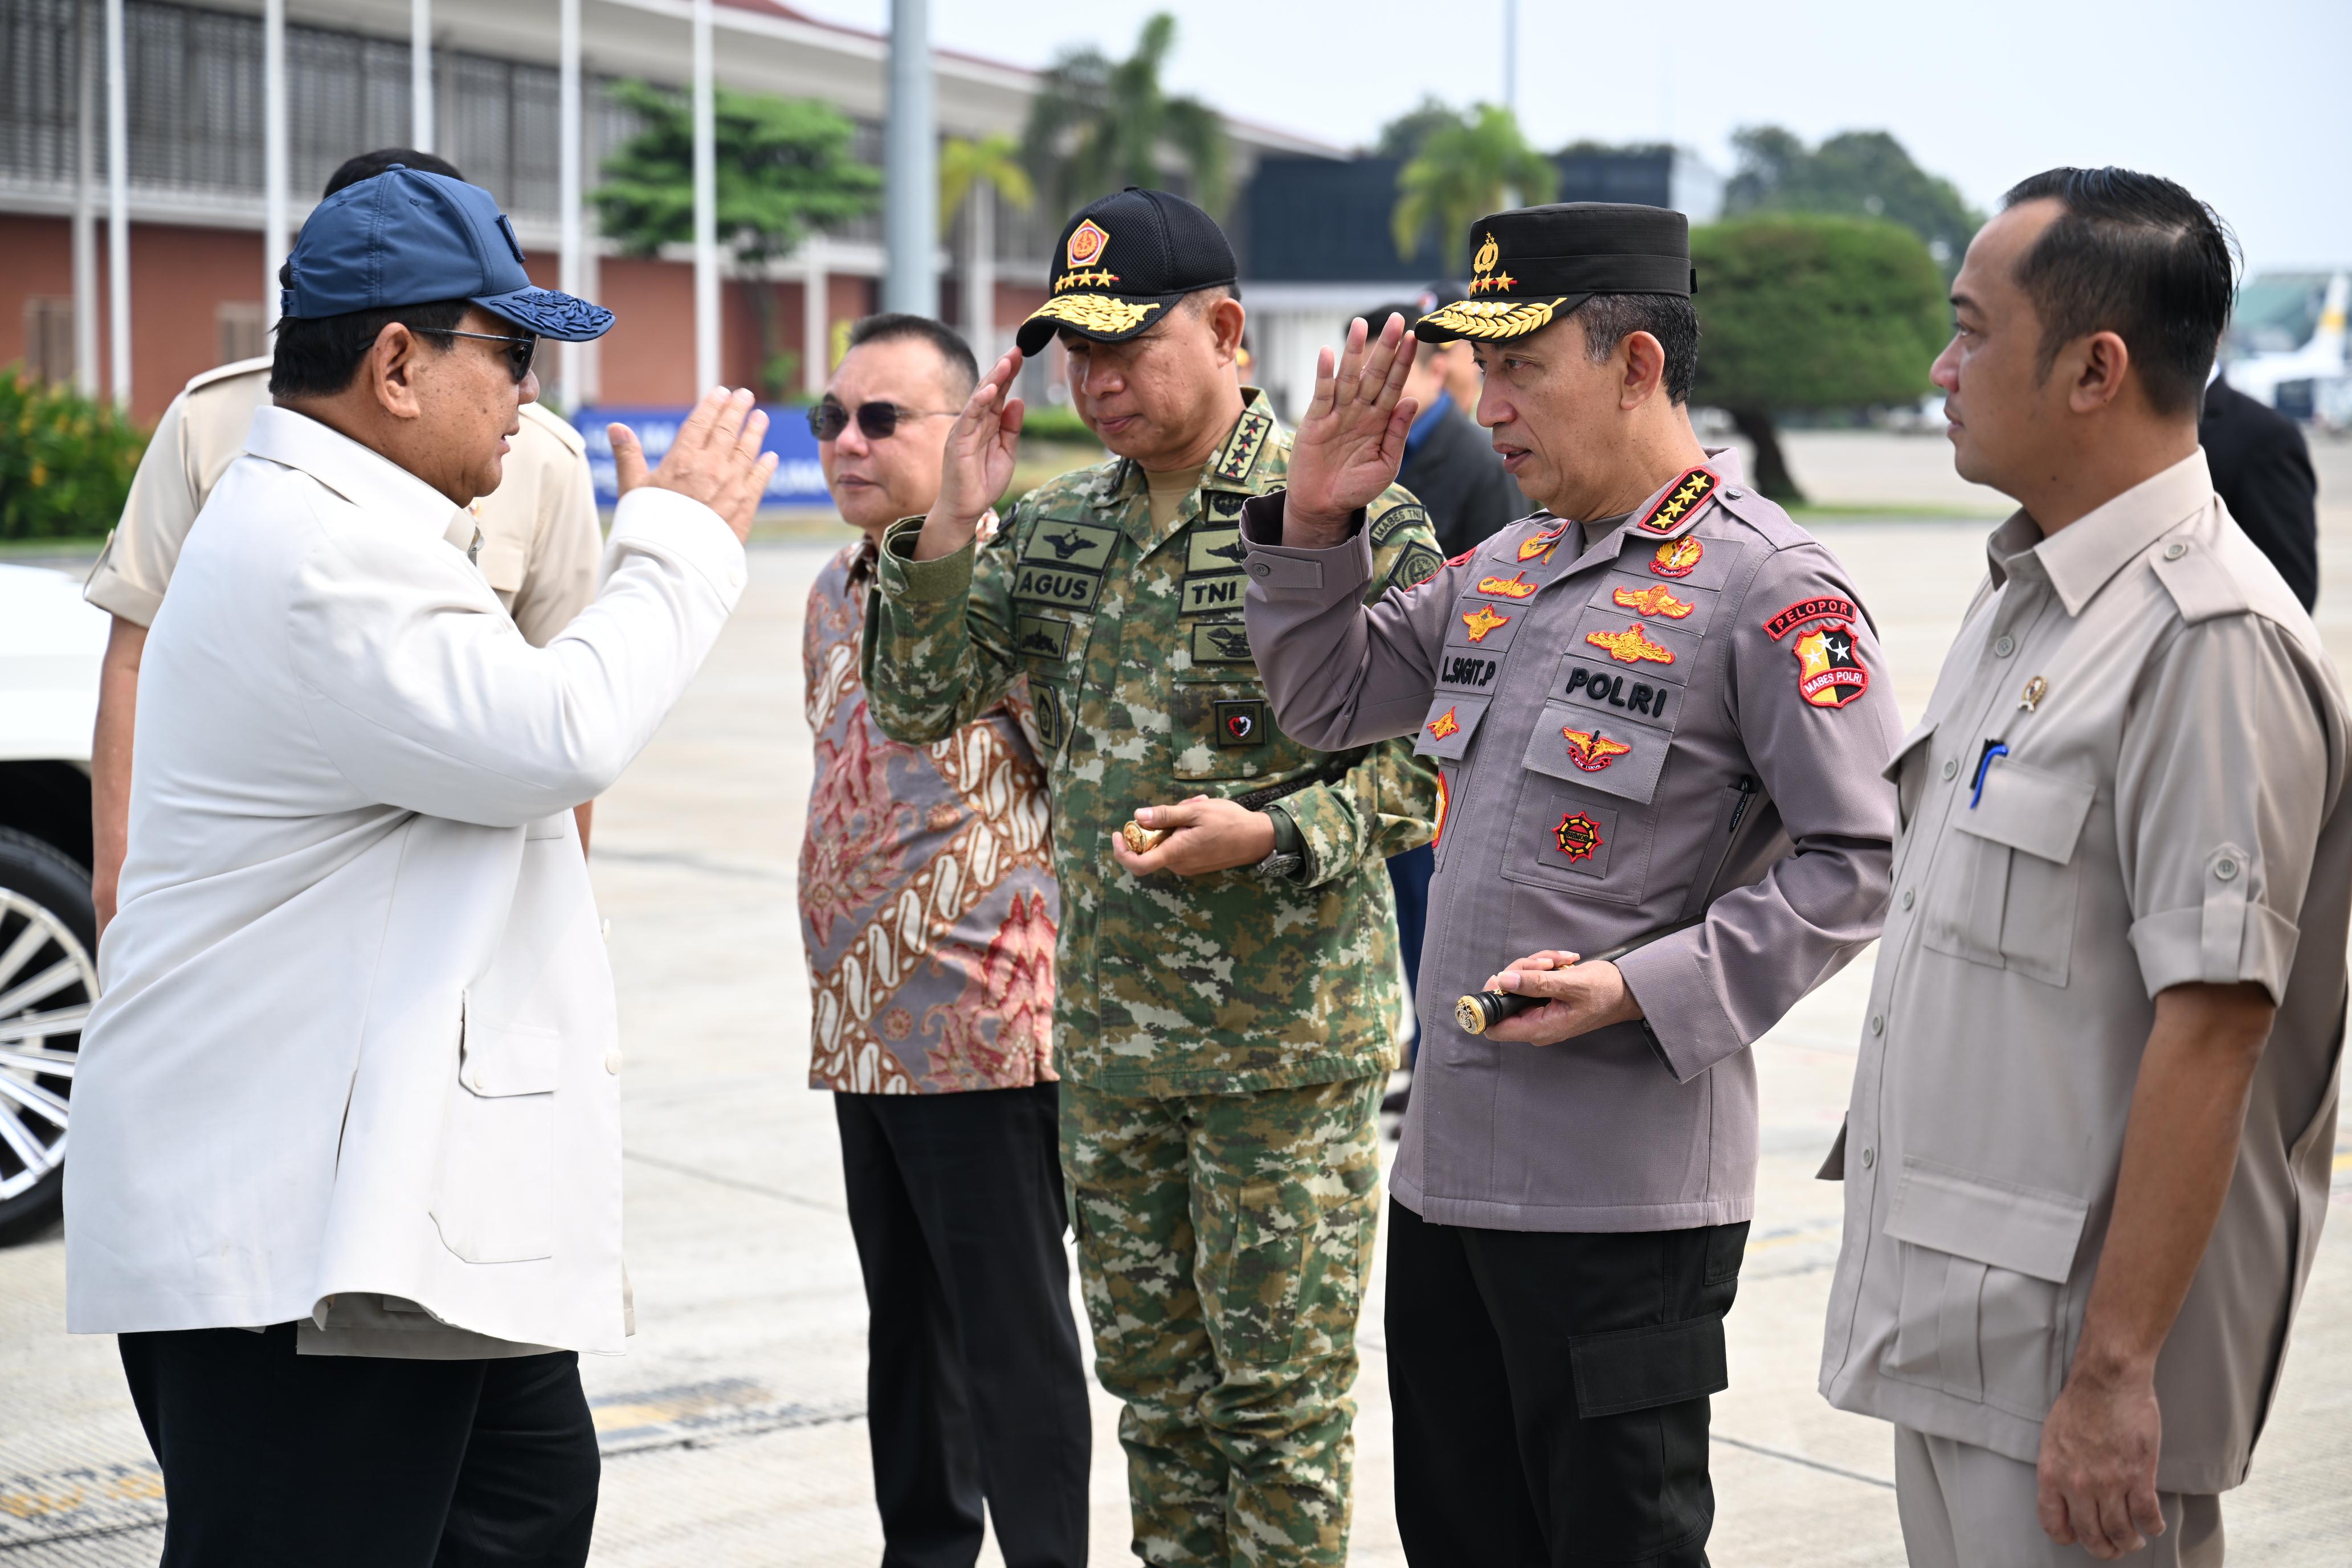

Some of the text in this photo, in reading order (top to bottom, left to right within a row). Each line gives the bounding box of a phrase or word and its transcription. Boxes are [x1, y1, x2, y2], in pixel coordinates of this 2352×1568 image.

[1375, 509, 1421, 538] MABES TNI
[1019, 571, 1088, 600] AGUS
[1192, 582, 1237, 605] TNI
[1775, 601, 1848, 630] PELOPOR
[1566, 667, 1667, 718] POLRI
[1804, 672, 1863, 693] MABES POLRI
